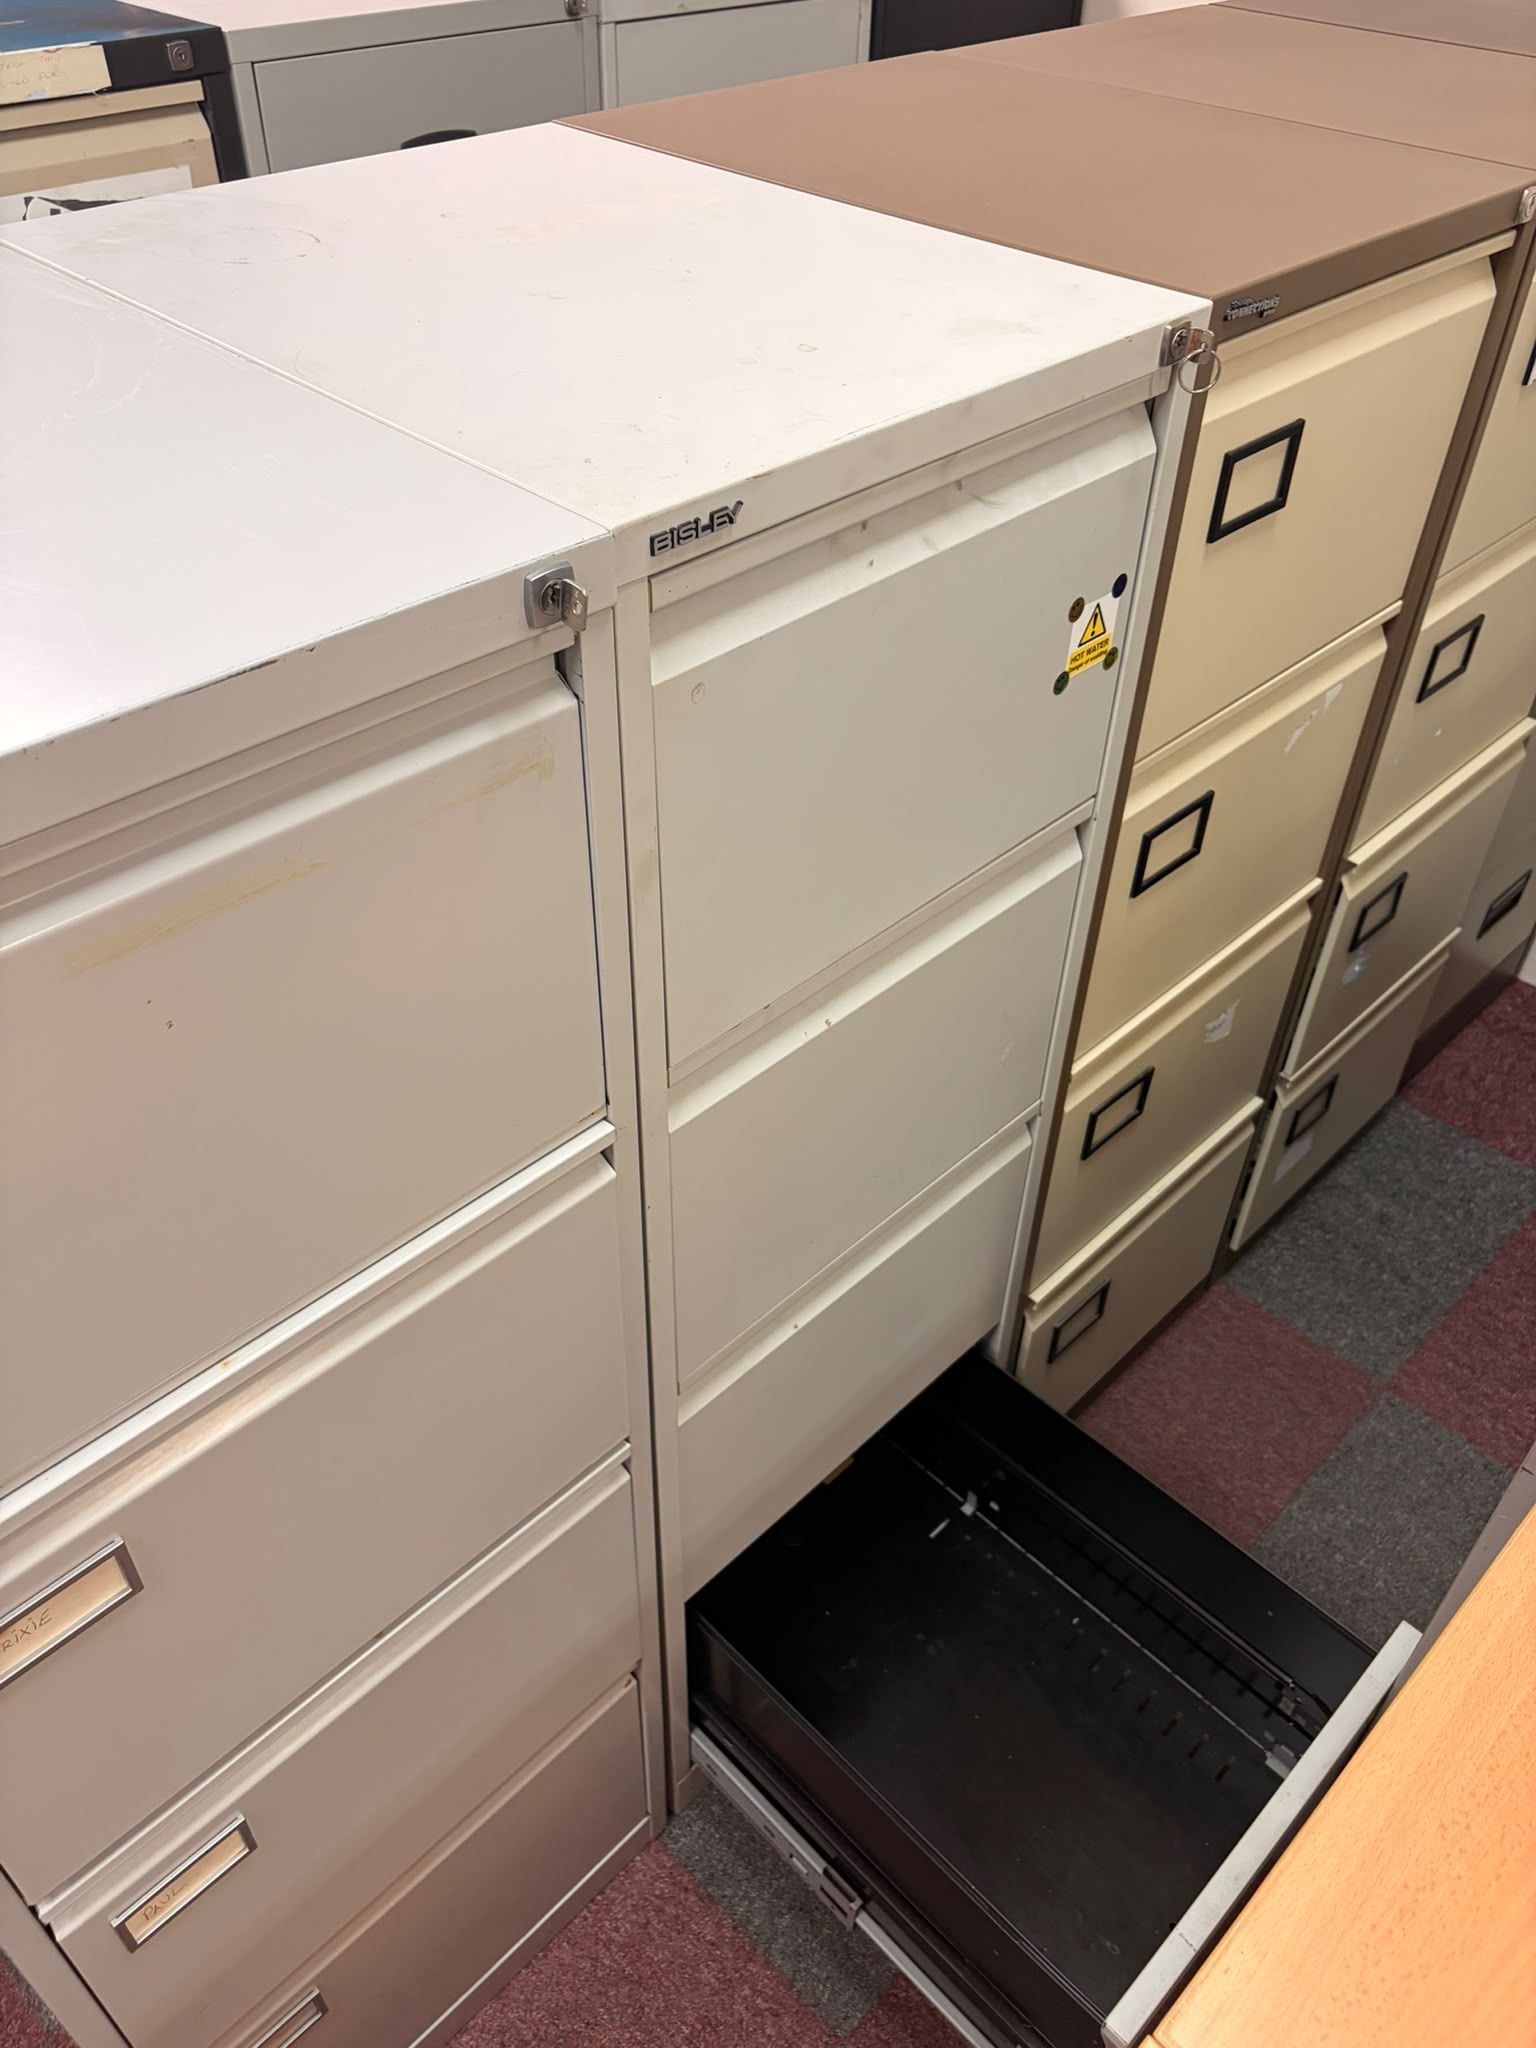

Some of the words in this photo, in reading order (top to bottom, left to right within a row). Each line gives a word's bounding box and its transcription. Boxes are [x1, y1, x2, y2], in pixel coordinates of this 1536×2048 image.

[649, 500, 744, 557] BISLEY
[1070, 650, 1086, 665] HOT
[1086, 638, 1109, 656] WATER
